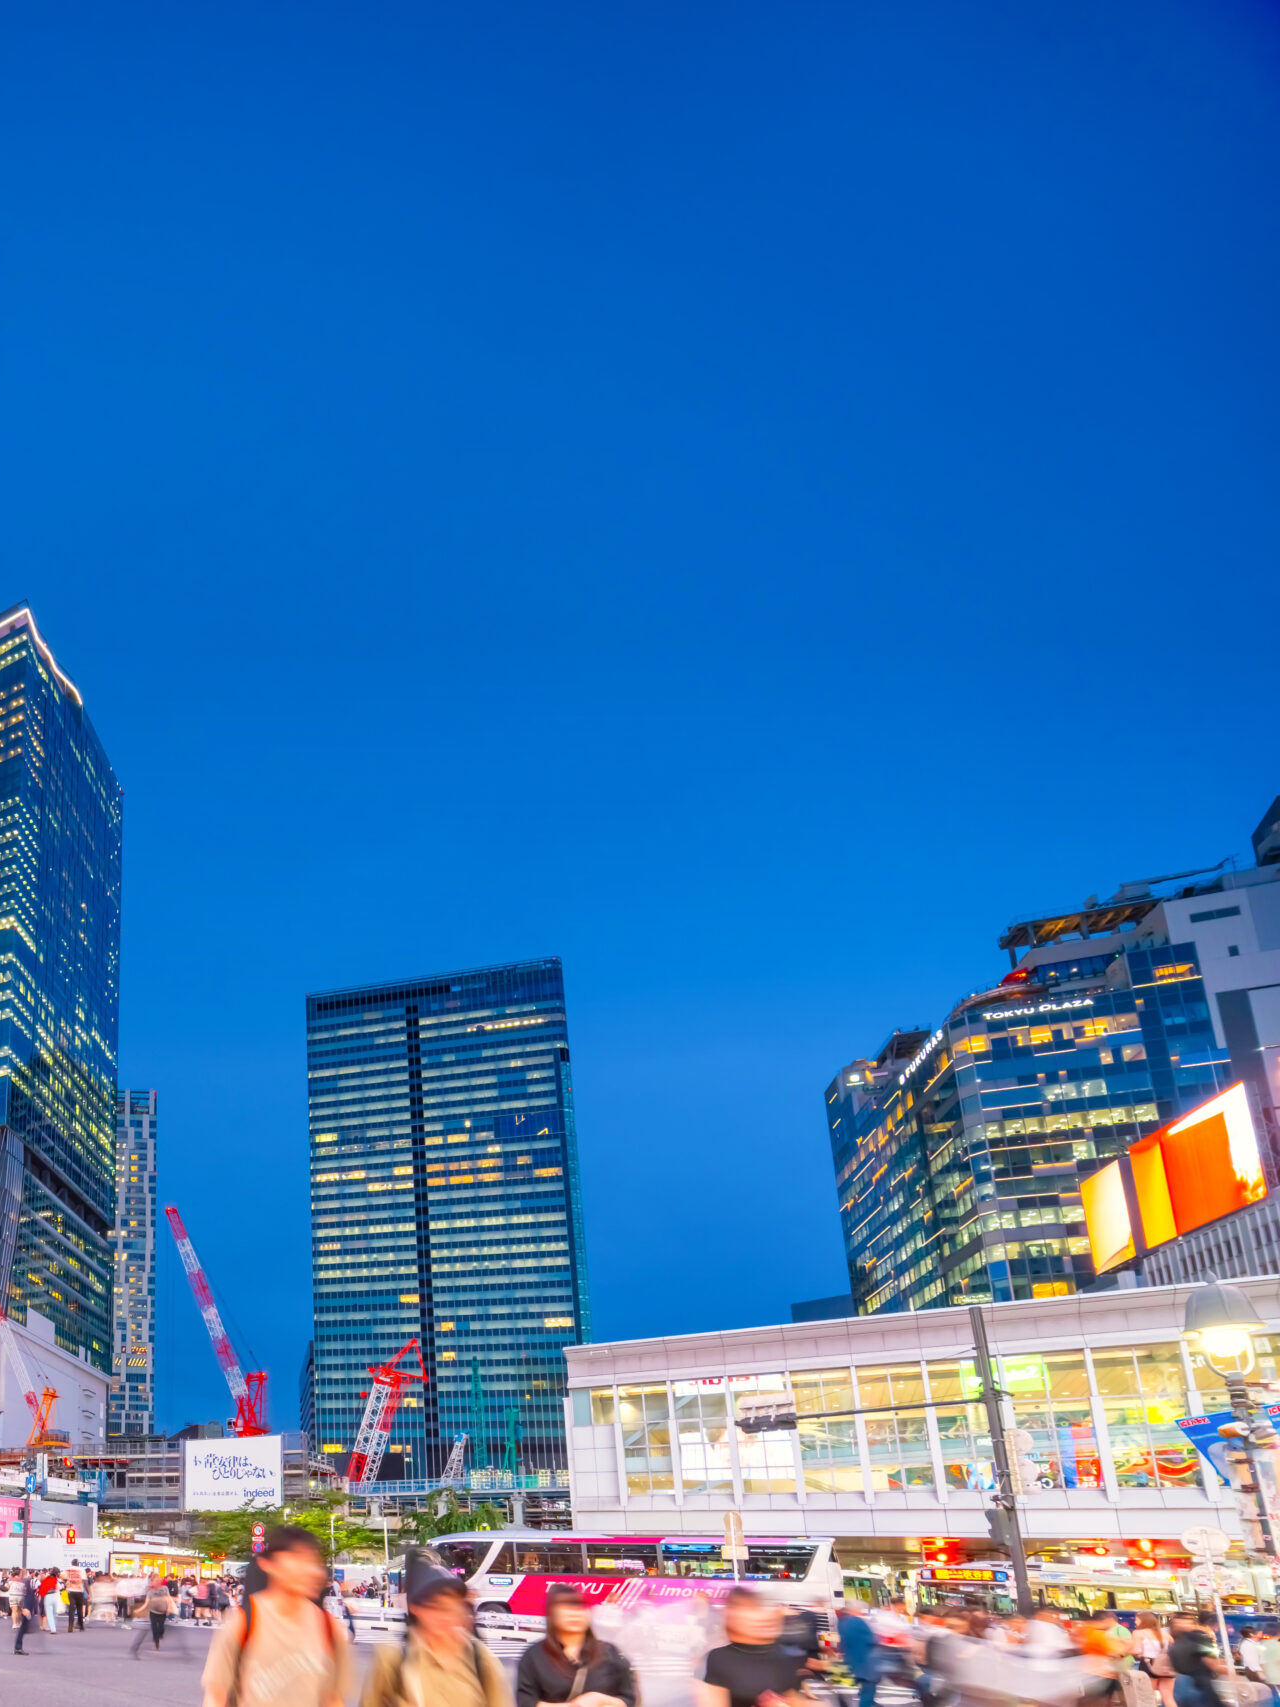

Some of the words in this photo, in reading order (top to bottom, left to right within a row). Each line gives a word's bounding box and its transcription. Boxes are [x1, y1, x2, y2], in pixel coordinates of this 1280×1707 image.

[983, 1007, 1035, 1020] TOKYU
[1039, 998, 1094, 1013] PLAZA
[904, 1029, 944, 1078] FUKURAS
[243, 1488, 275, 1498] indeed
[545, 1581, 604, 1595] TYU
